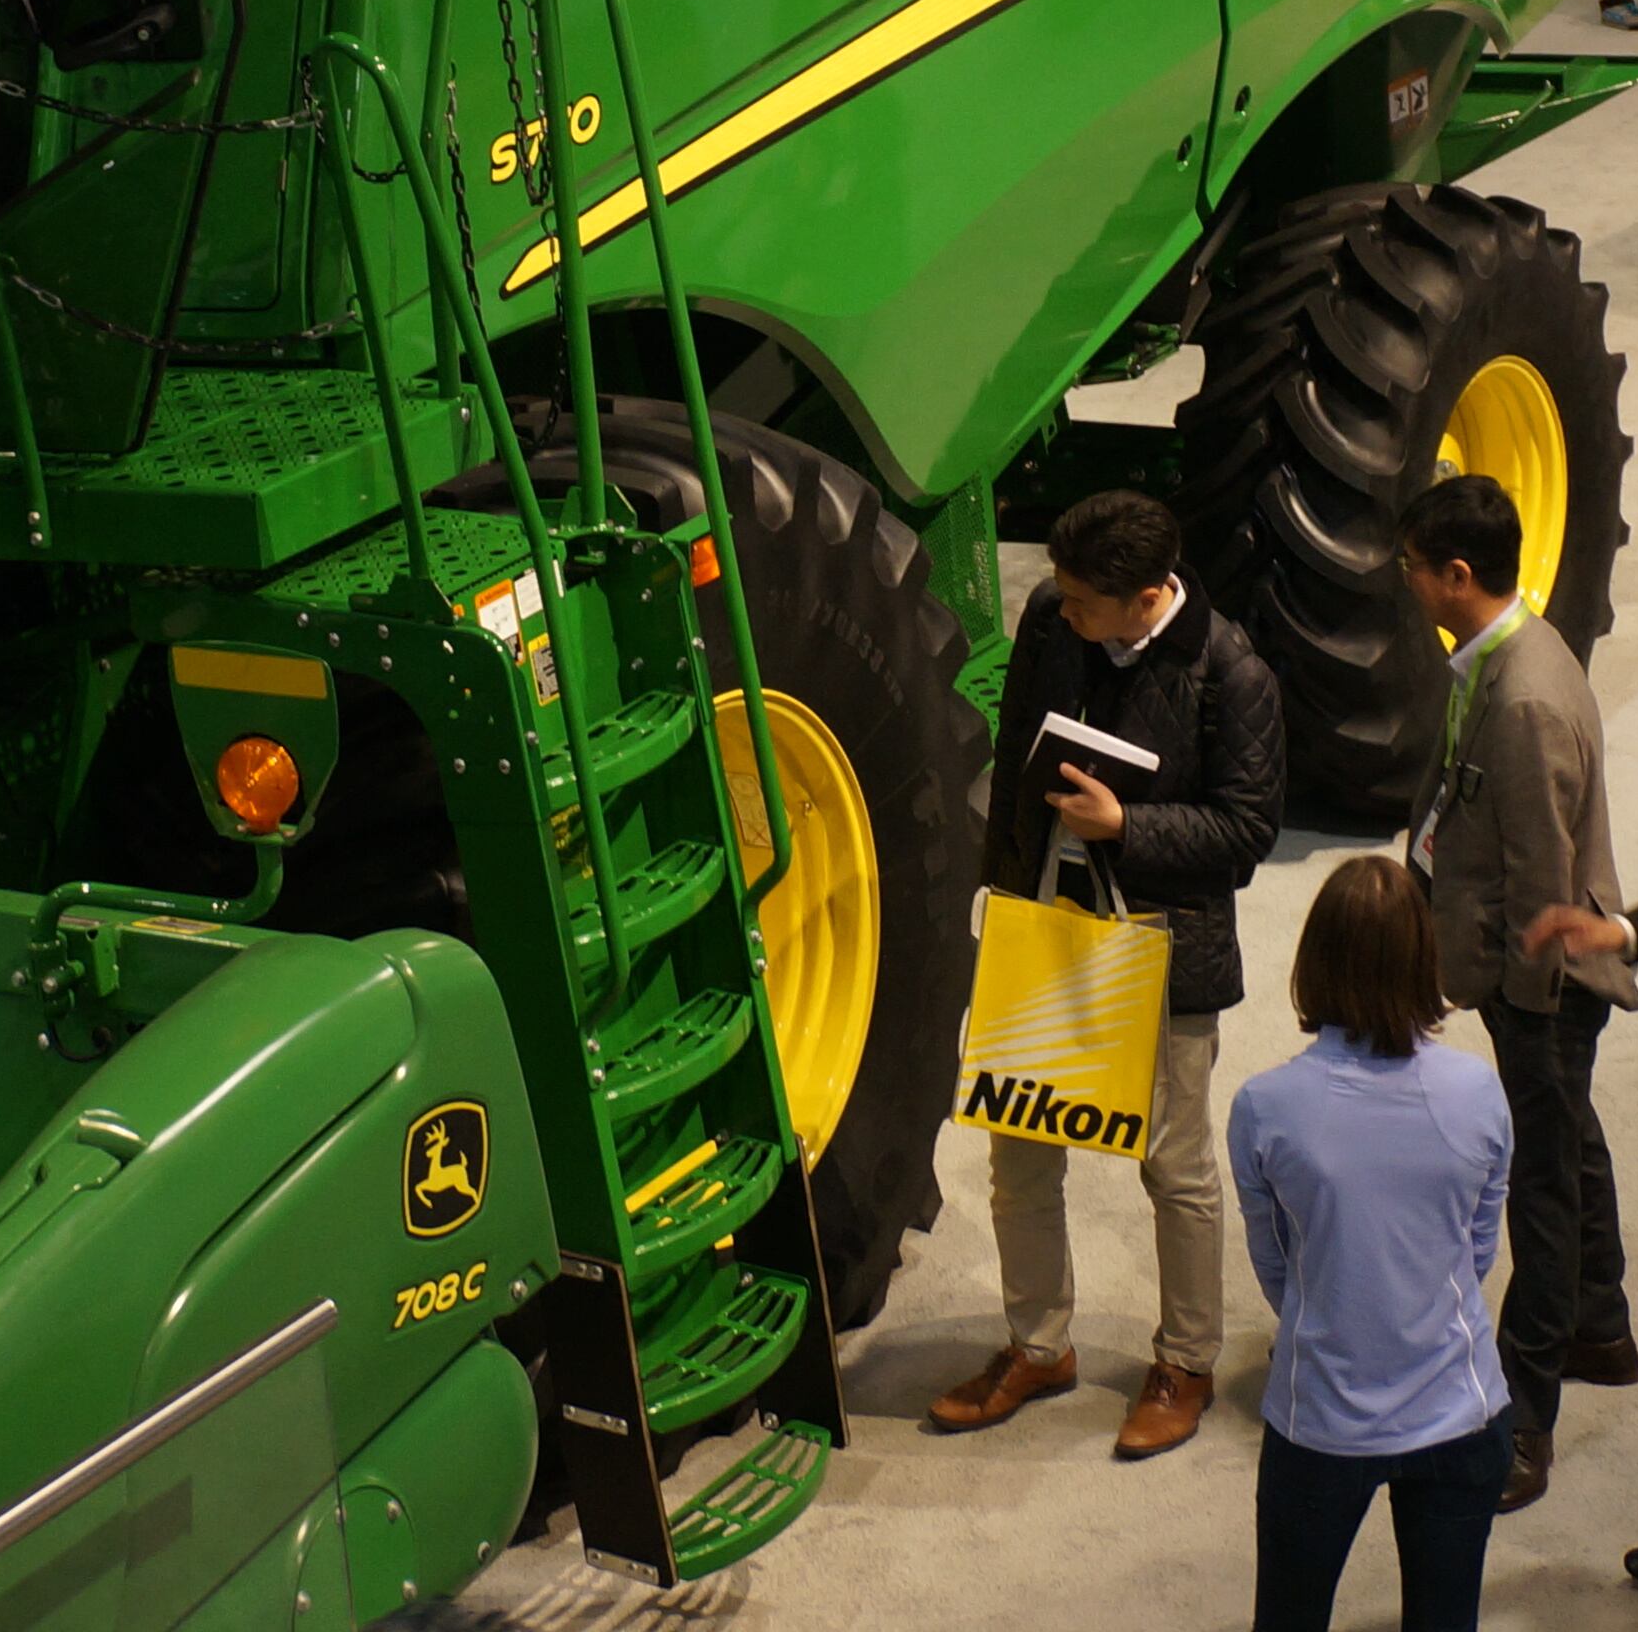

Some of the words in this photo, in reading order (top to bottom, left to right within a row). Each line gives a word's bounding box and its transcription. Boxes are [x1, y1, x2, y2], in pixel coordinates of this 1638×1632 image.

[490, 94, 602, 184] S70
[963, 1070, 1144, 1150] Nikon
[394, 1272, 461, 1329] 708
[463, 1261, 488, 1301] C
